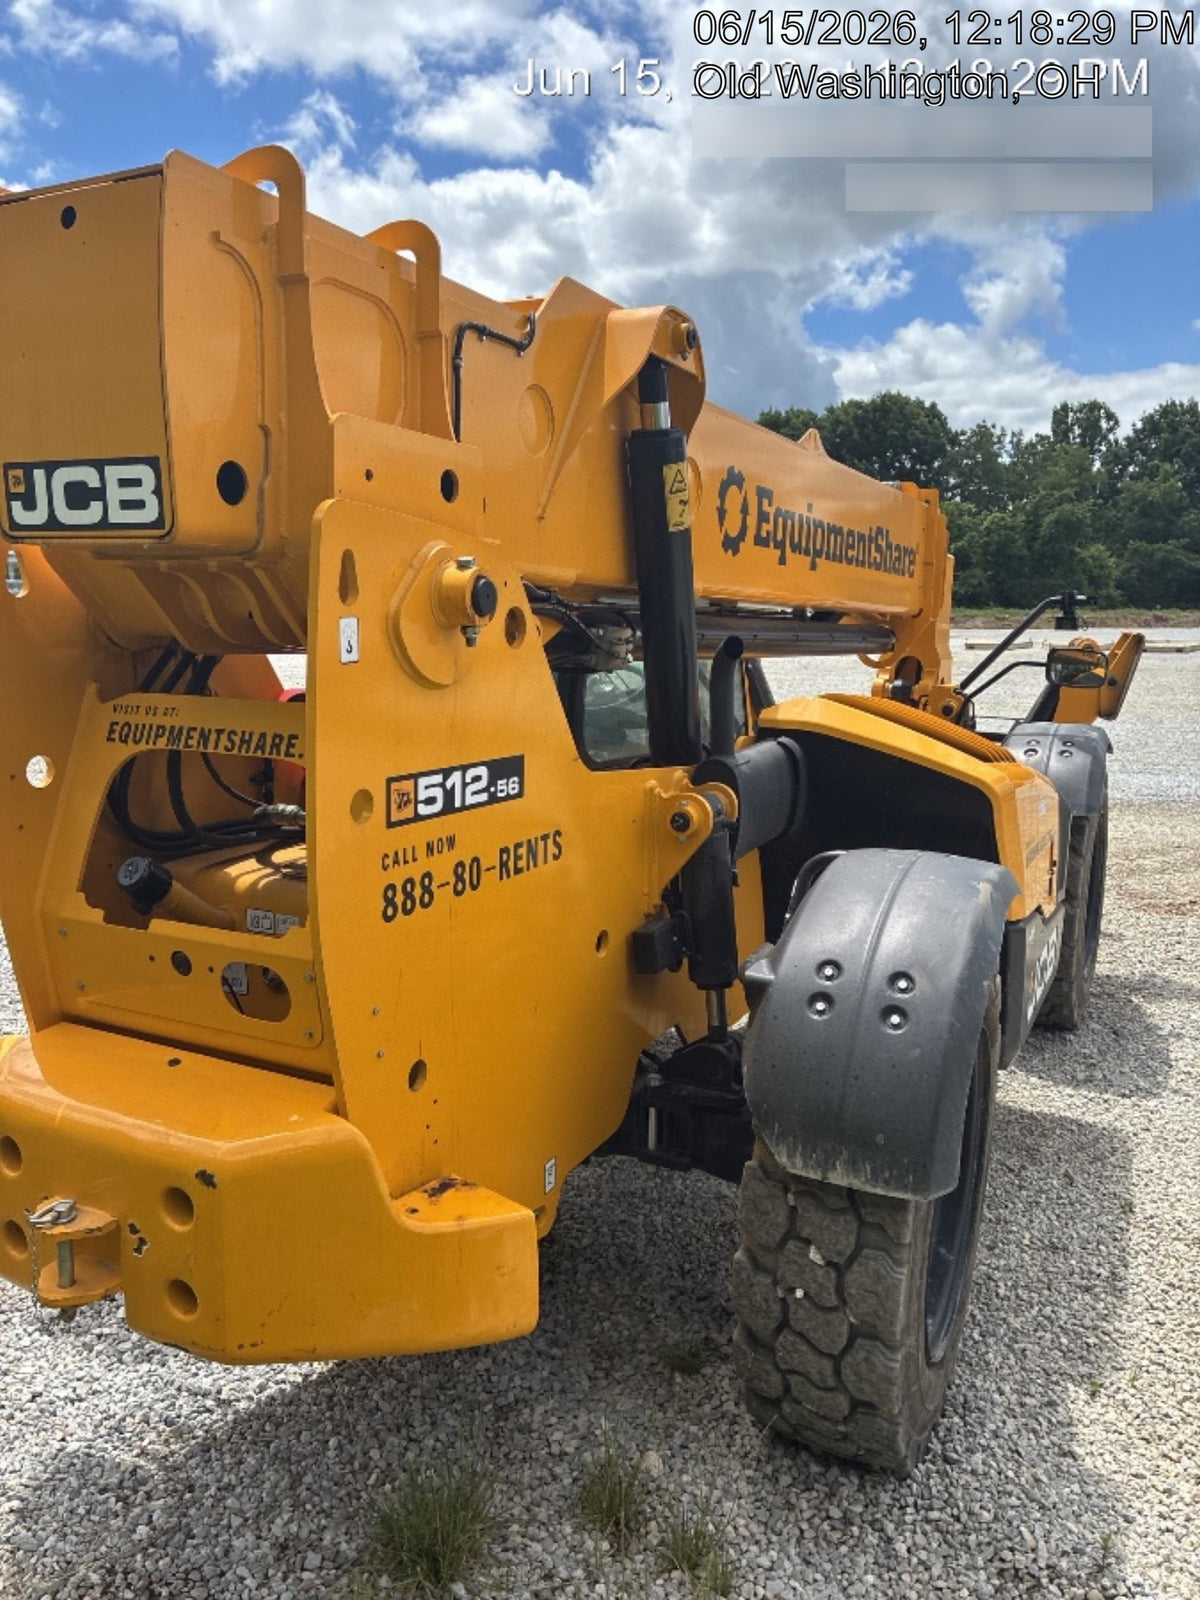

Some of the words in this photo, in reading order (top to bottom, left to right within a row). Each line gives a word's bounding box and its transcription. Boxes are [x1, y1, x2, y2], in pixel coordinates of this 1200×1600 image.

[10, 463, 160, 526] JCB
[754, 485, 917, 578] EquipmentShare
[112, 703, 141, 716] VISIT
[145, 705, 159, 717] US
[163, 706, 180, 717] AT:
[381, 846, 418, 871] CALL
[426, 833, 456, 857] NOW
[381, 829, 563, 923] 888-80-RENTS
